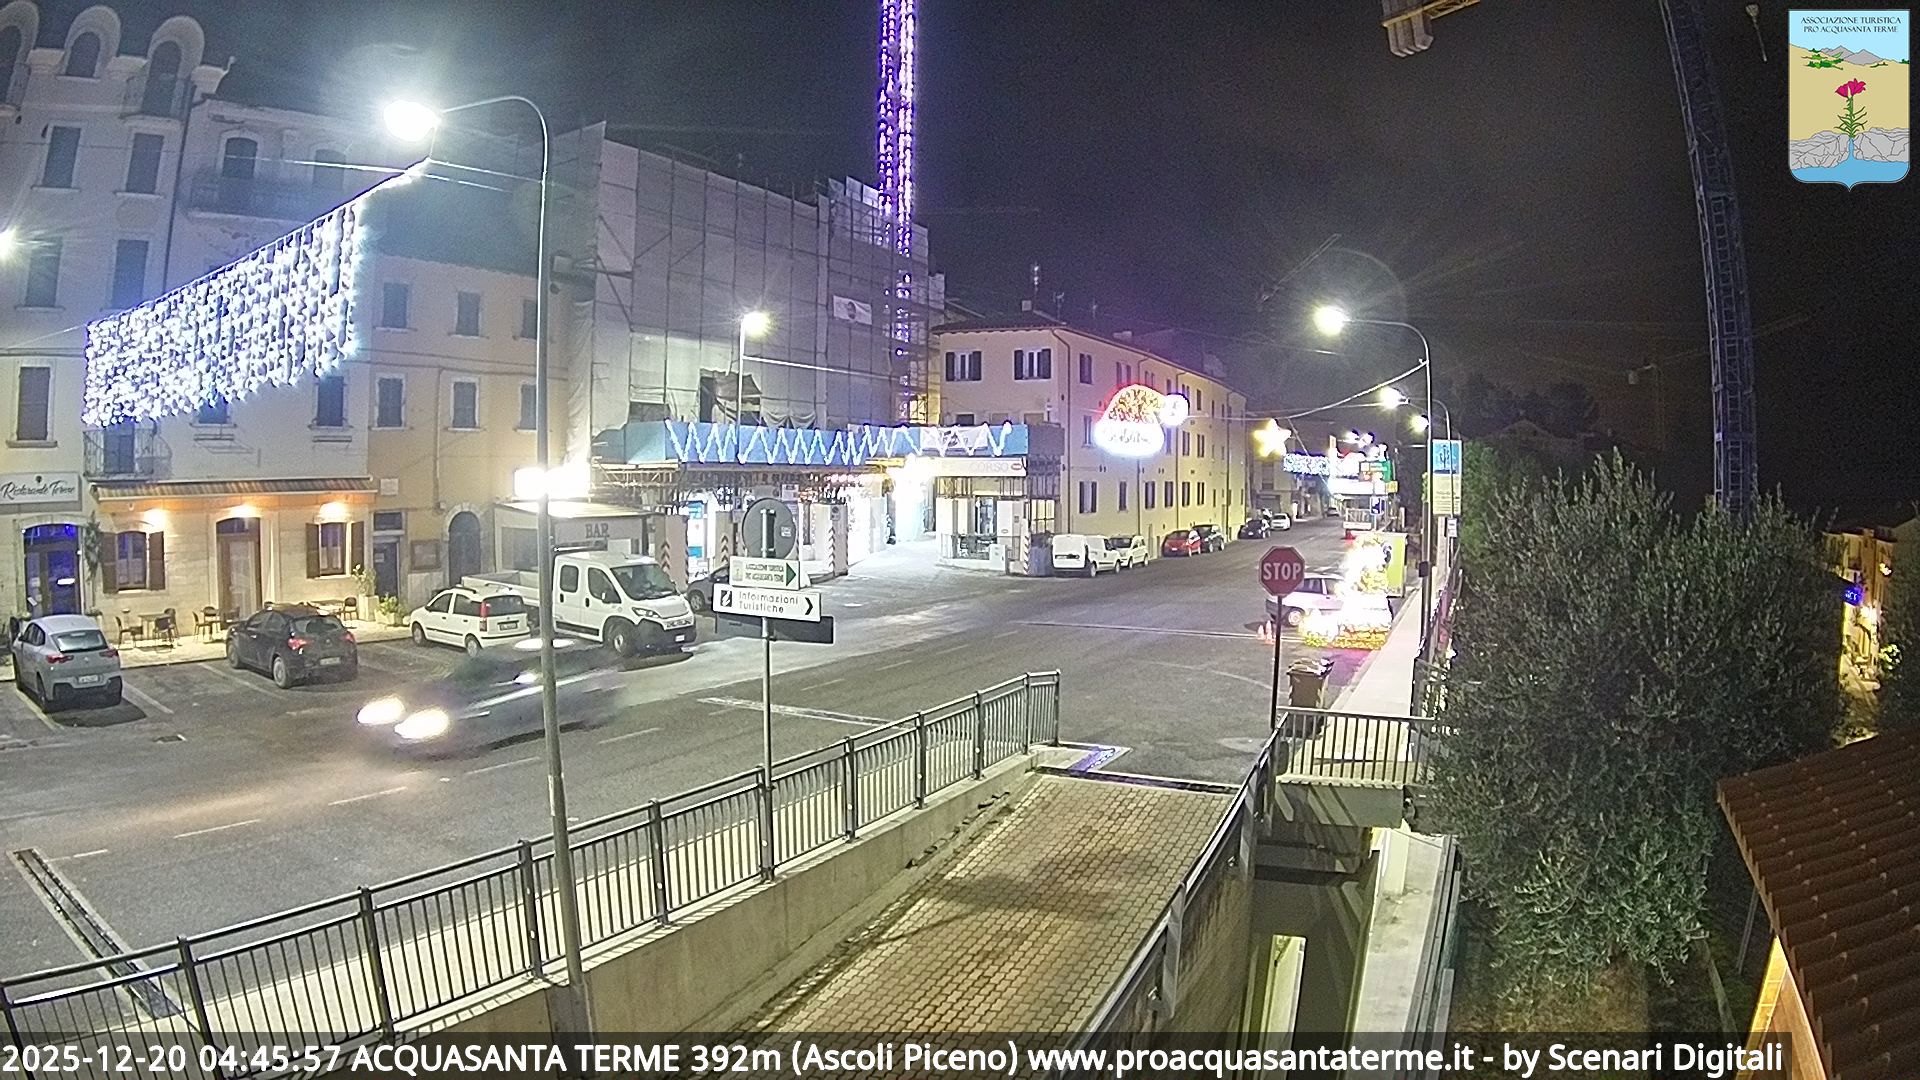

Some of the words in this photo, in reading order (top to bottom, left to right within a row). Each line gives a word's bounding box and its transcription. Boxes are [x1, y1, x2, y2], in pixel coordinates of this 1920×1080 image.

[970, 462, 1009, 473] CORSO
[585, 522, 609, 539] BAR
[1263, 562, 1302, 580] STOP
[739, 591, 799, 605] Informazioni
[739, 600, 784, 614] Turistiche
